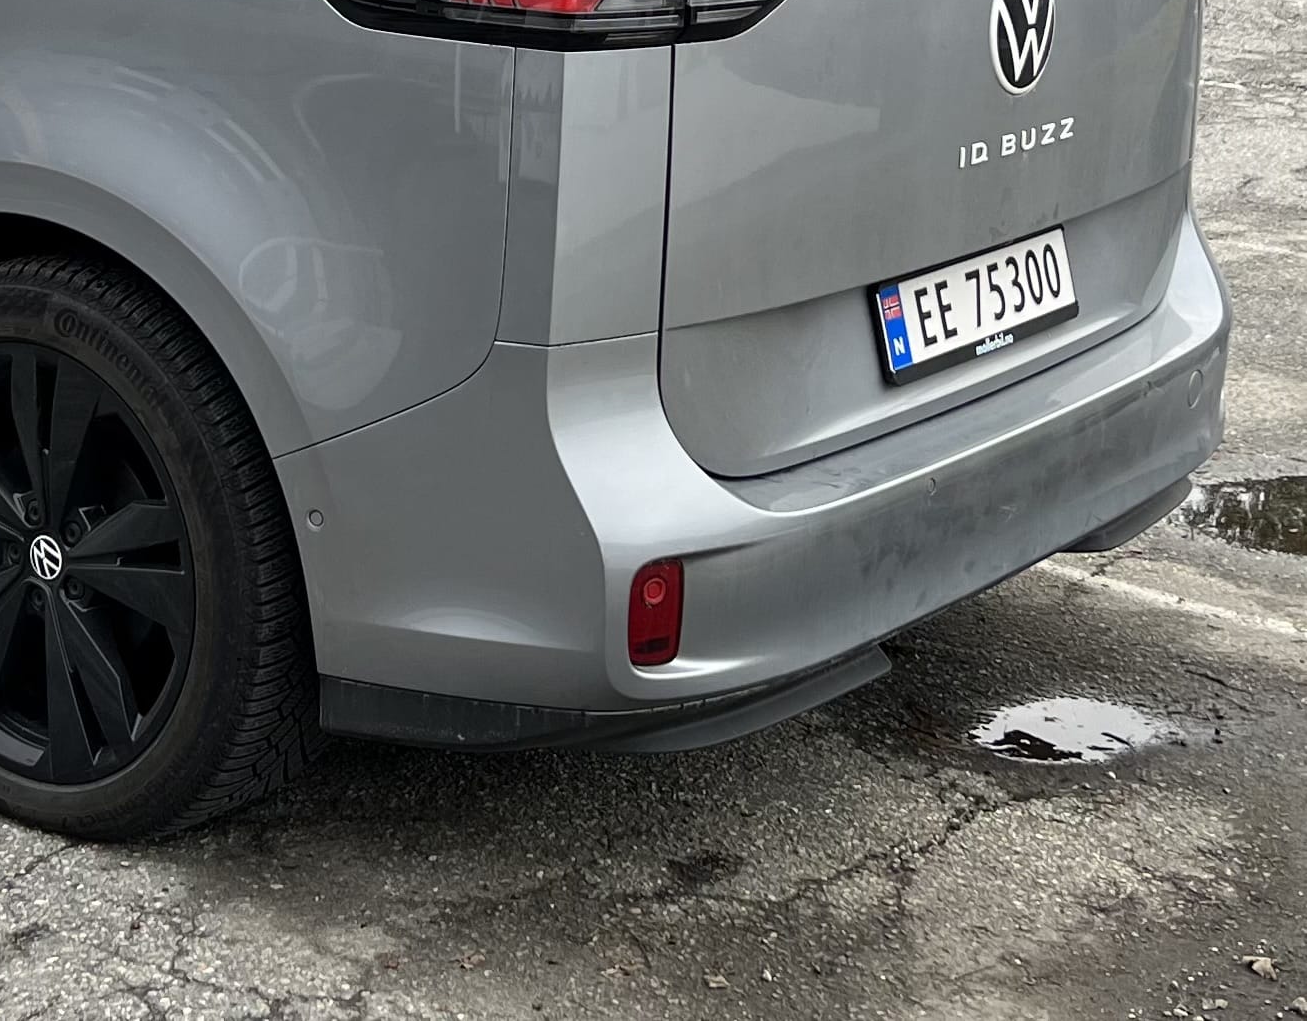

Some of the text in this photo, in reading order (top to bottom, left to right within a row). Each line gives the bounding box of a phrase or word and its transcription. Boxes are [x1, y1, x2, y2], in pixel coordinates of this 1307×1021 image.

[1001, 116, 1075, 157] BUZZ
[914, 243, 1061, 348] EE 75300
[893, 335, 906, 356] N
